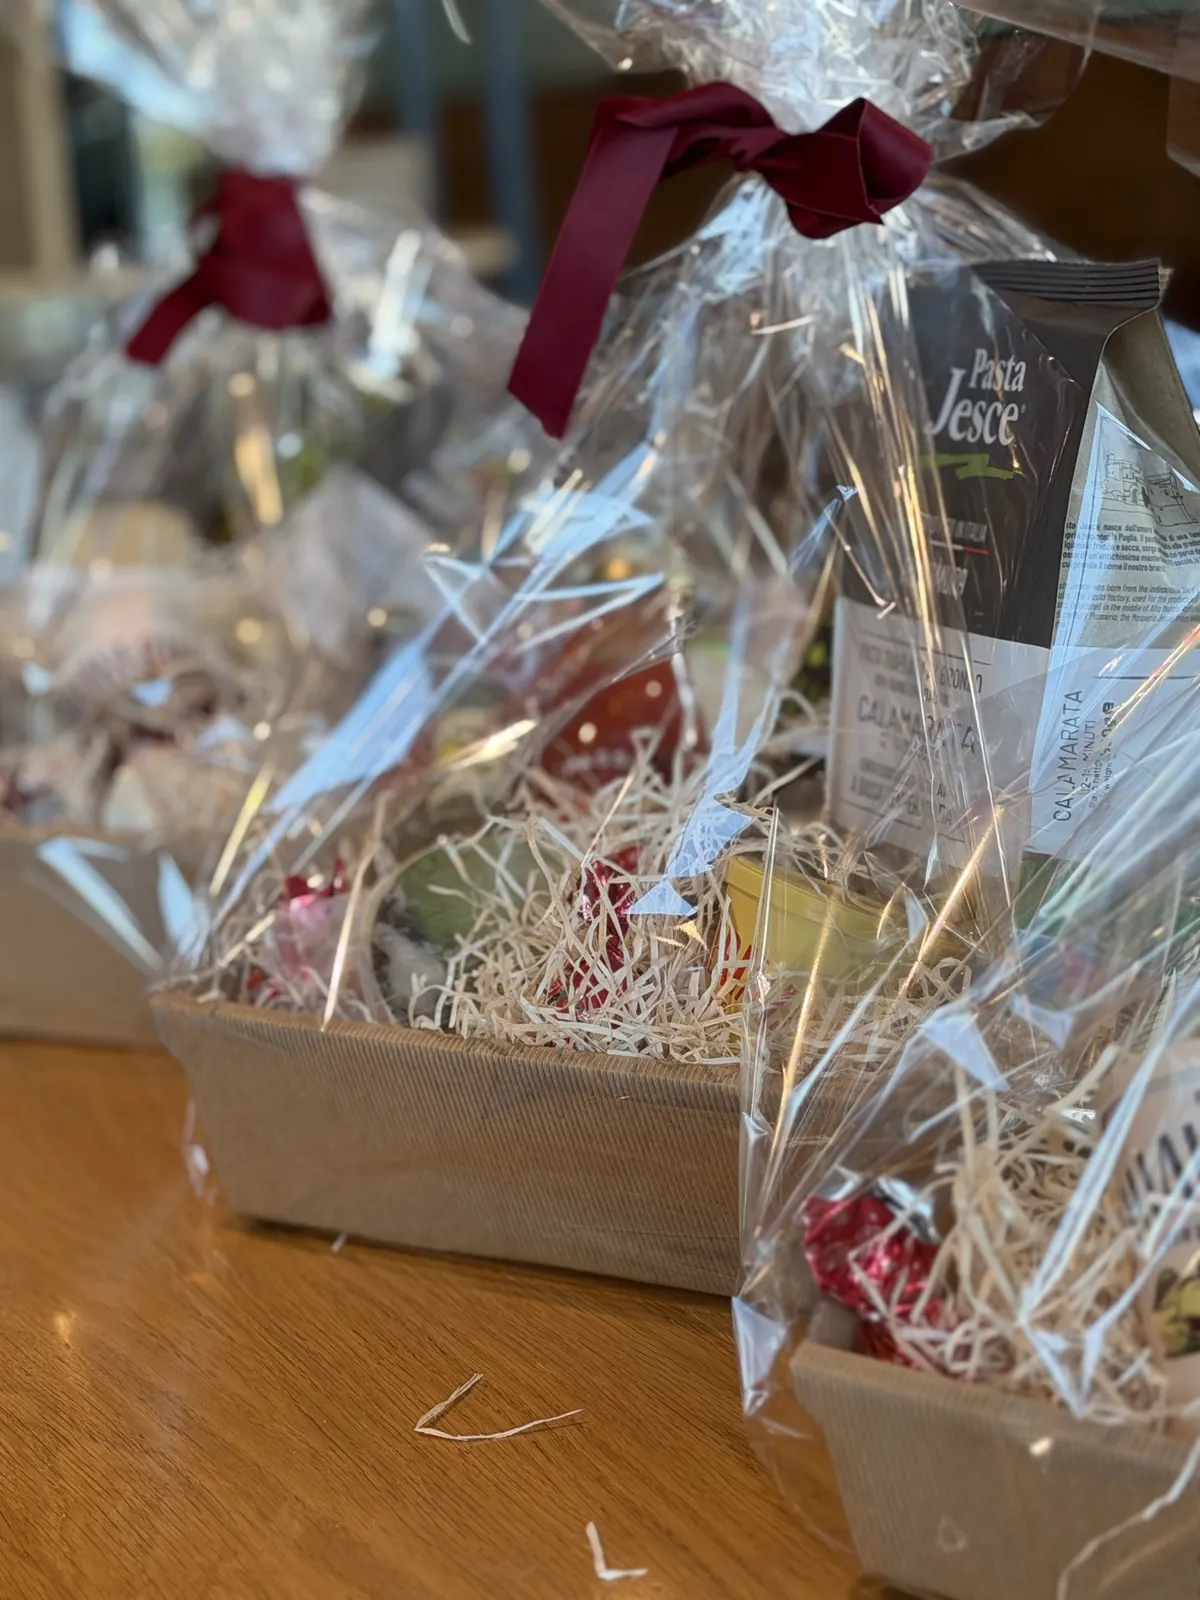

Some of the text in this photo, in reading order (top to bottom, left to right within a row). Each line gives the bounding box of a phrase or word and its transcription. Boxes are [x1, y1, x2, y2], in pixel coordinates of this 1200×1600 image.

[967, 348, 1027, 392] Pasta
[923, 366, 1020, 446] Jesce
[1129, 562, 1148, 571] nostro
[1107, 592, 1129, 604] factory,
[1123, 584, 1137, 592] from
[1053, 690, 1083, 822] CALAMARATA
